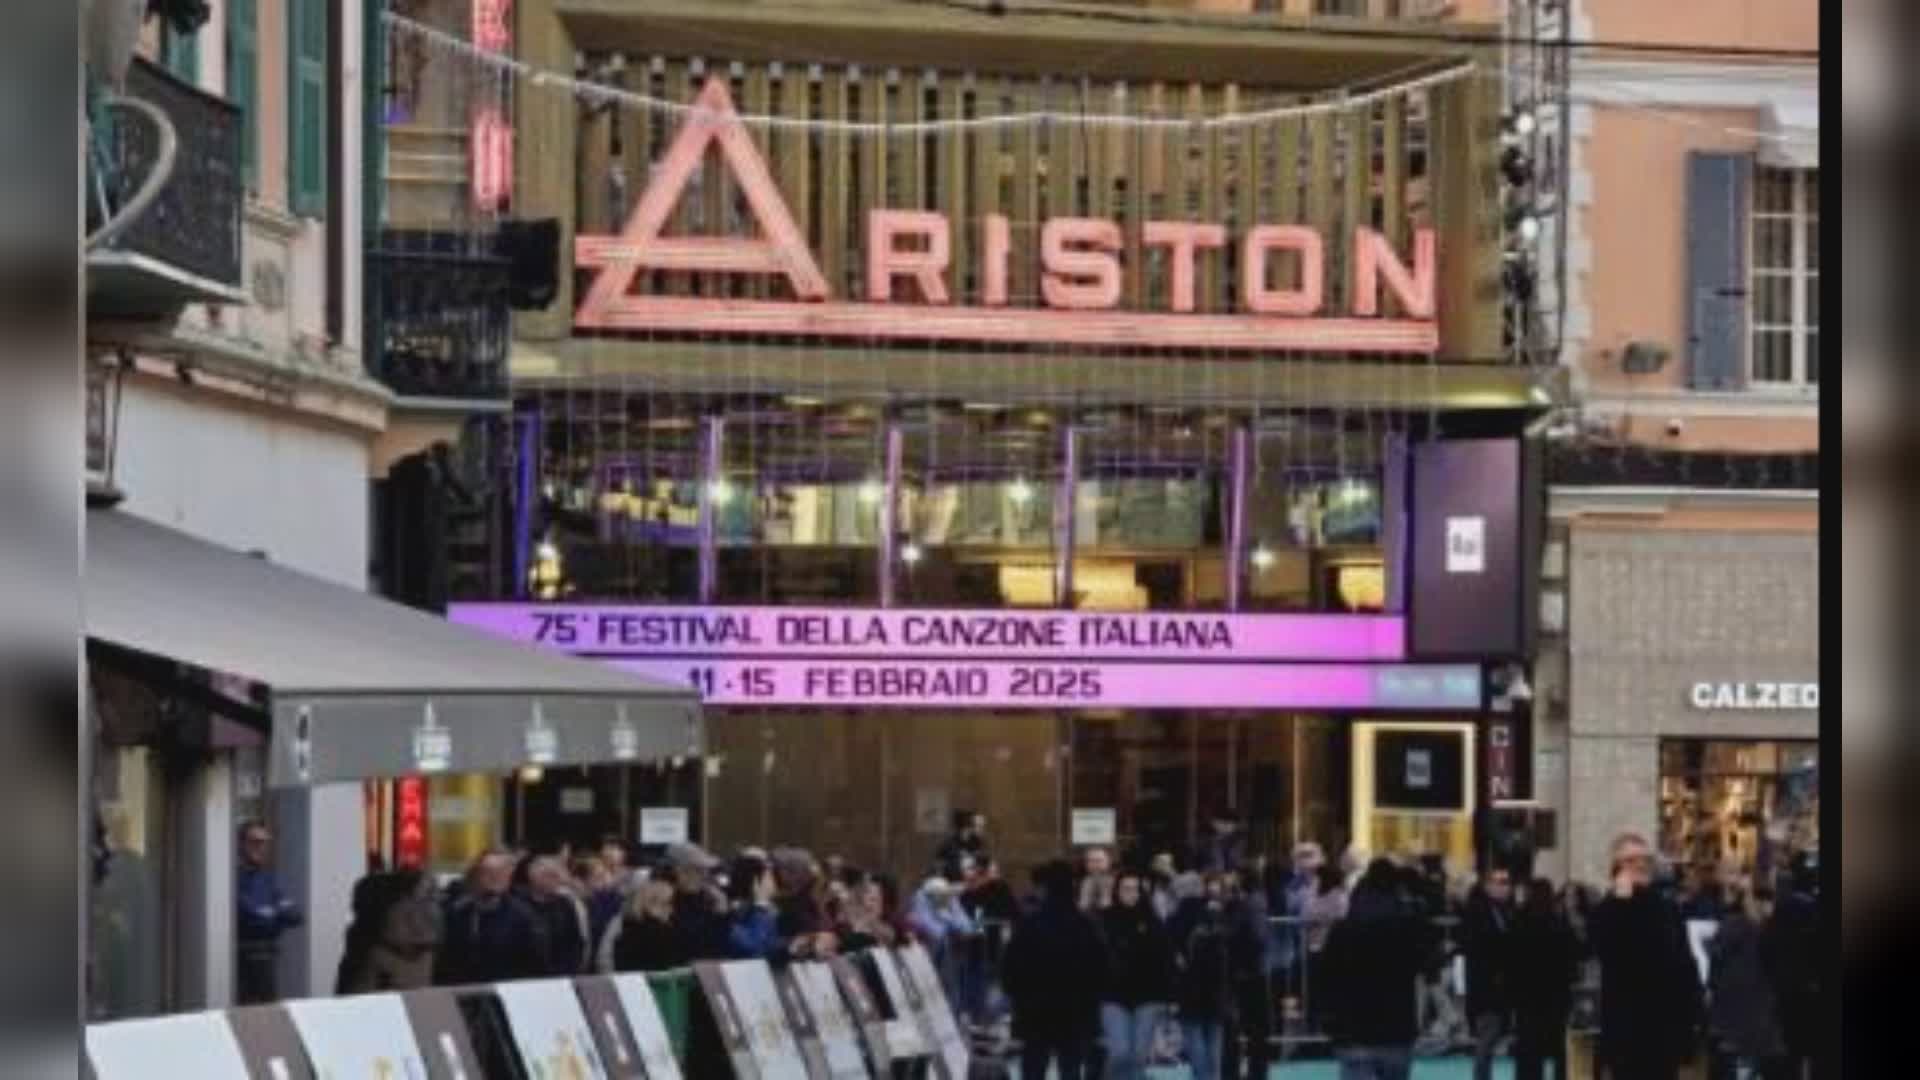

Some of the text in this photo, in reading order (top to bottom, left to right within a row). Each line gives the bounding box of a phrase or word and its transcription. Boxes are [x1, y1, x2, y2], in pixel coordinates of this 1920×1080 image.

[575, 75, 1438, 352] ARISTON
[597, 613, 762, 645] FESTIVAL
[777, 615, 888, 645] DELLA
[903, 616, 1066, 646] CANZONE
[1079, 617, 1233, 648] ITALIANA
[804, 667, 988, 697] FEBBRAIO
[1009, 667, 1102, 697] 2025
